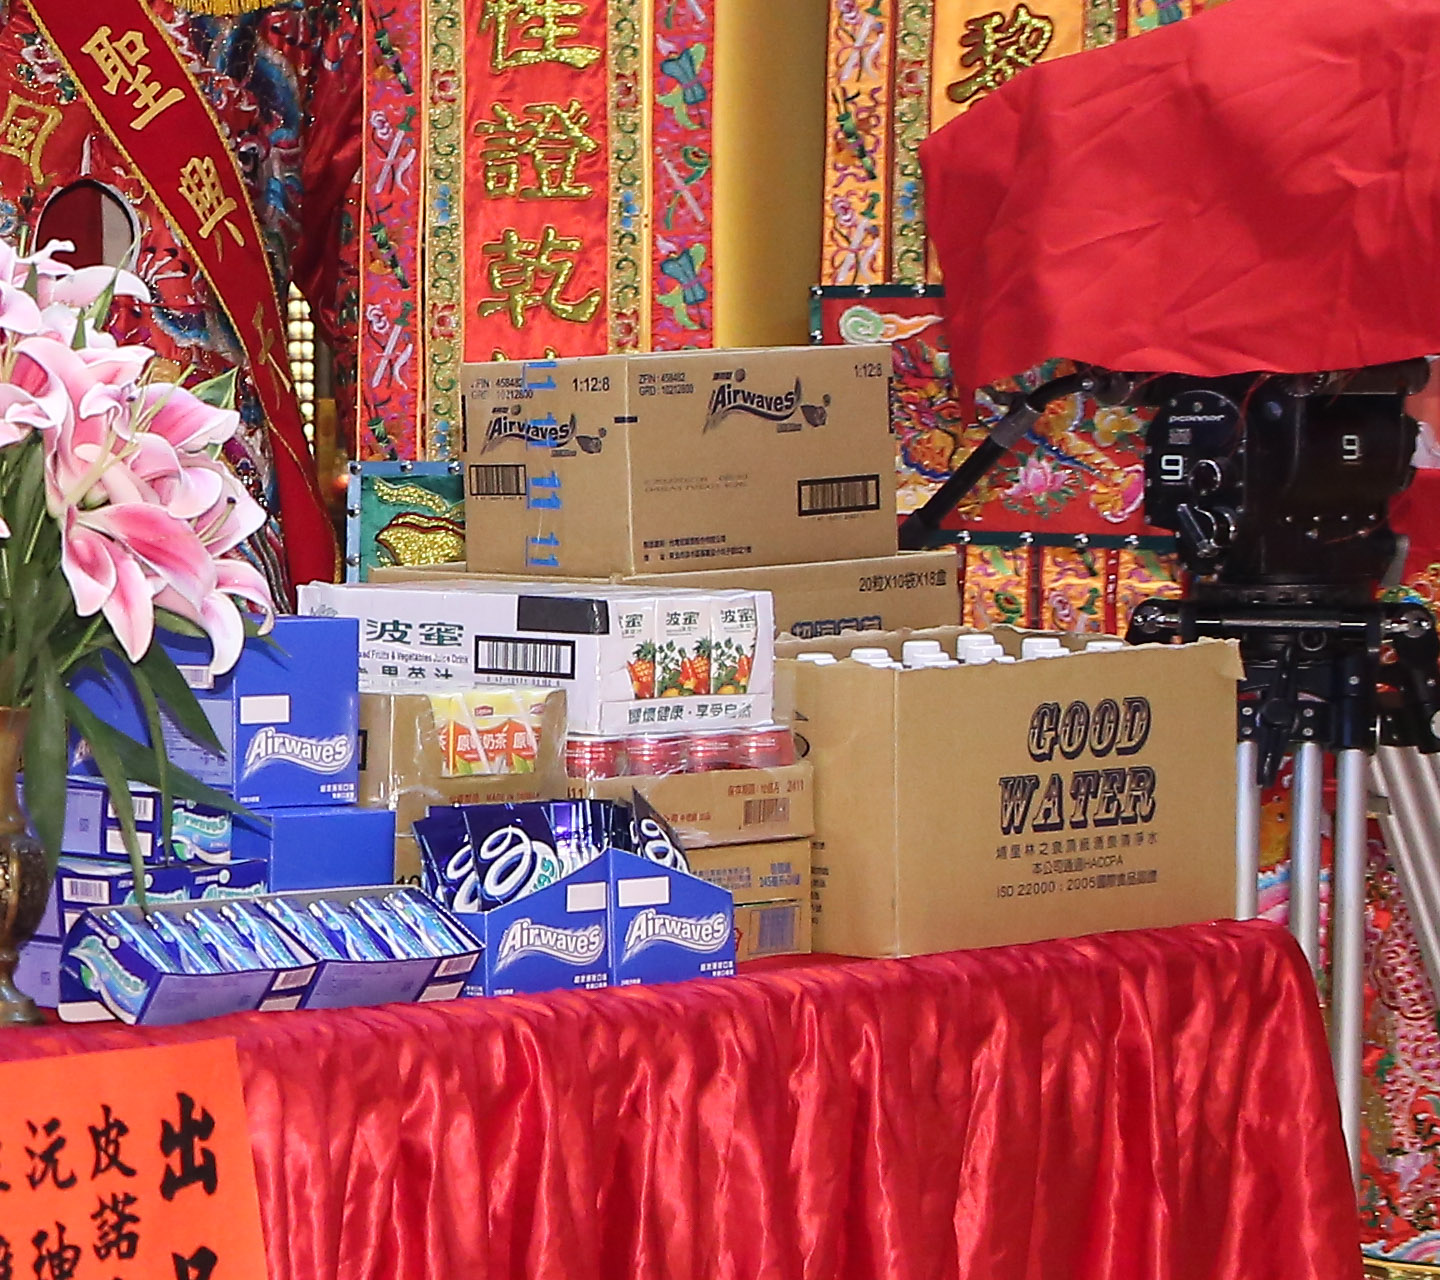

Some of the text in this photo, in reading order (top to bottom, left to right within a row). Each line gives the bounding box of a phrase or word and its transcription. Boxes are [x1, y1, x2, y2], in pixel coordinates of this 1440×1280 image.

[572, 376, 611, 393] 1:12:8
[713, 381, 795, 414] Airwaves
[488, 415, 573, 440] Airwaves
[1341, 434, 1360, 460] 9
[1160, 454, 1184, 480] 9
[365, 618, 466, 647] 波蜜
[665, 610, 701, 627] 波蜜
[1026, 695, 1152, 762] GOOD
[252, 730, 349, 768] Airwaves
[996, 766, 1158, 836] WATER
[996, 885, 1014, 898] ISO
[1017, 881, 1056, 897] 22000
[501, 918, 602, 958] Airwaves
[627, 909, 727, 946] Airwaves
